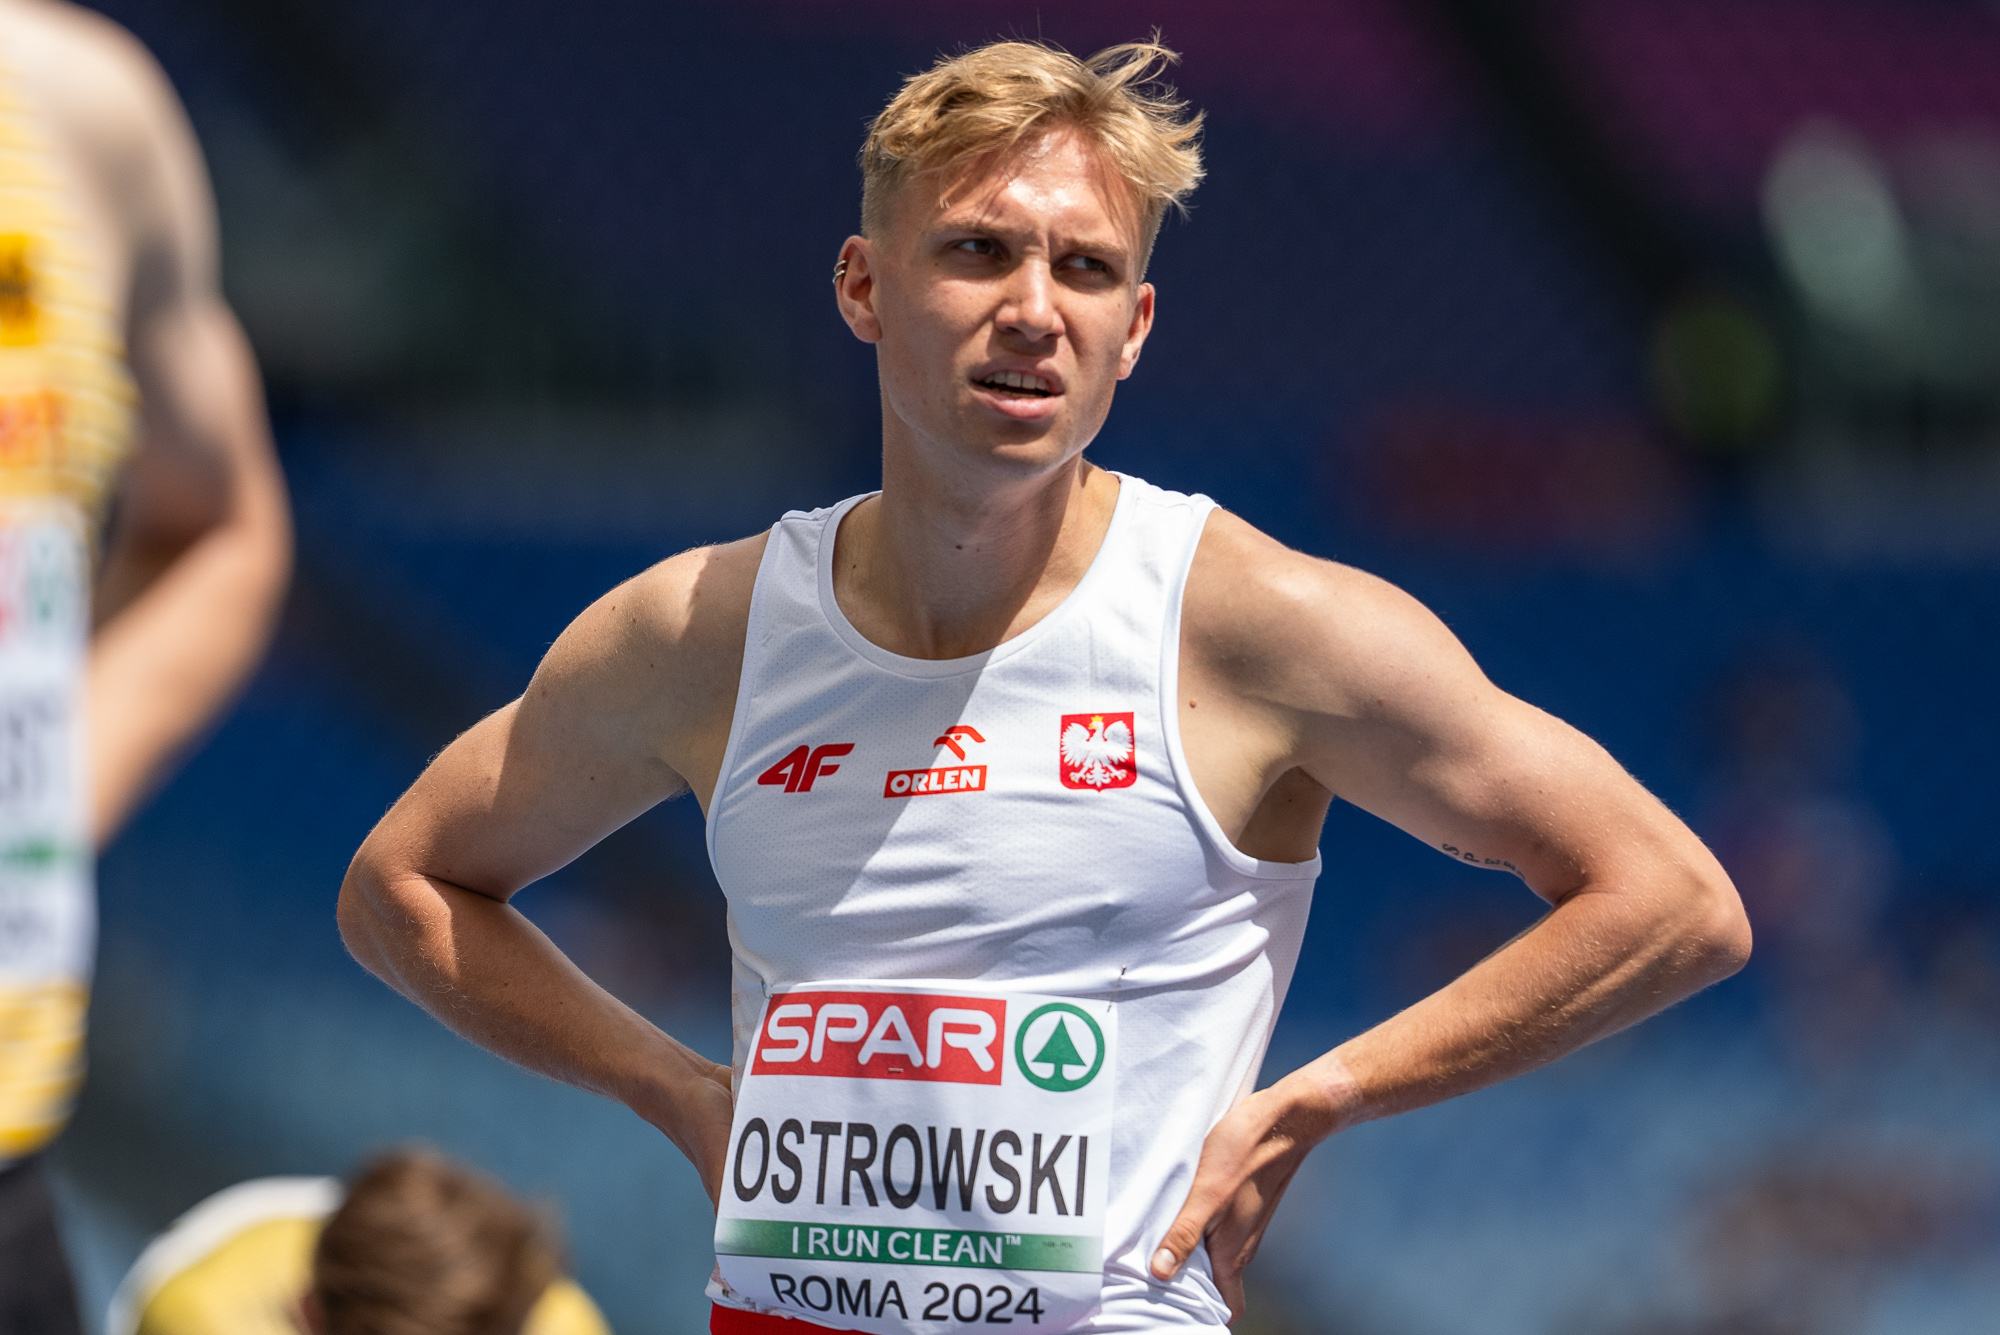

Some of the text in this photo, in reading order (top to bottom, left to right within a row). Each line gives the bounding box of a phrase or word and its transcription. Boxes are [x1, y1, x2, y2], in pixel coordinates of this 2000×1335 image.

[757, 743, 855, 792] 4F
[890, 768, 981, 794] ORLEN
[761, 1003, 997, 1072] SPAR
[733, 1118, 1088, 1216] OSTROWSKI
[792, 1226, 798, 1254] I
[808, 1226, 880, 1258] RUN
[769, 1273, 1046, 1324] ROMA 2024
